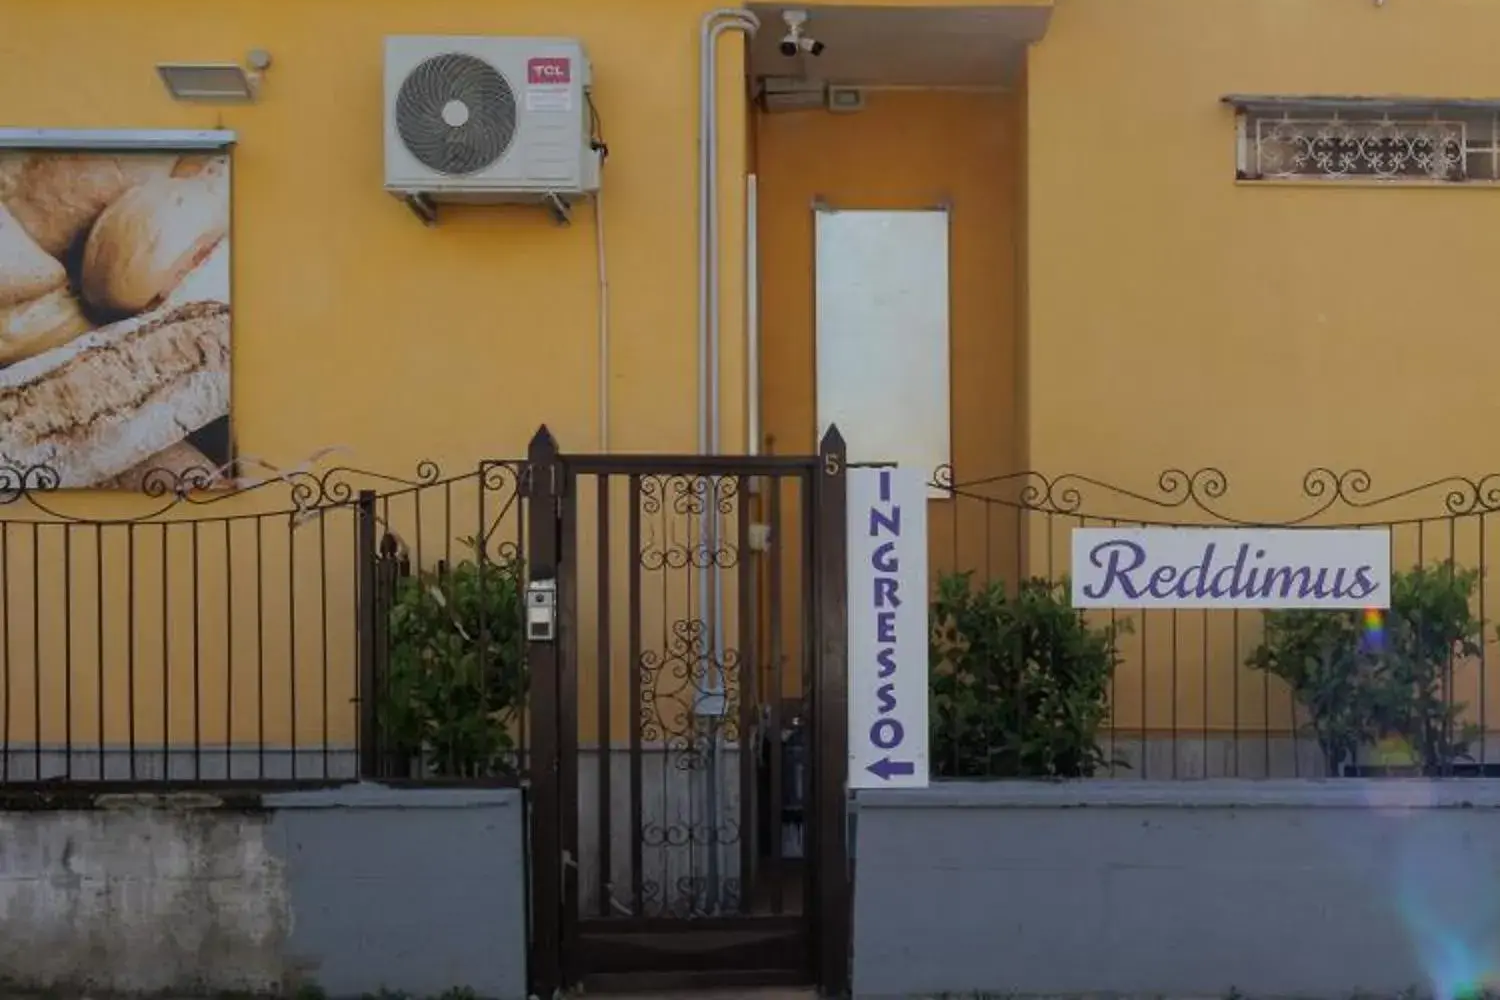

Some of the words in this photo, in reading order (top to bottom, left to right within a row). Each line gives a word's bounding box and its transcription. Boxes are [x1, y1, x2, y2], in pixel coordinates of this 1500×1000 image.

[533, 65, 564, 77] TCL
[825, 453, 840, 476] 5
[1082, 539, 1380, 599] Reddimus
[869, 471, 905, 749] INGRESSO
